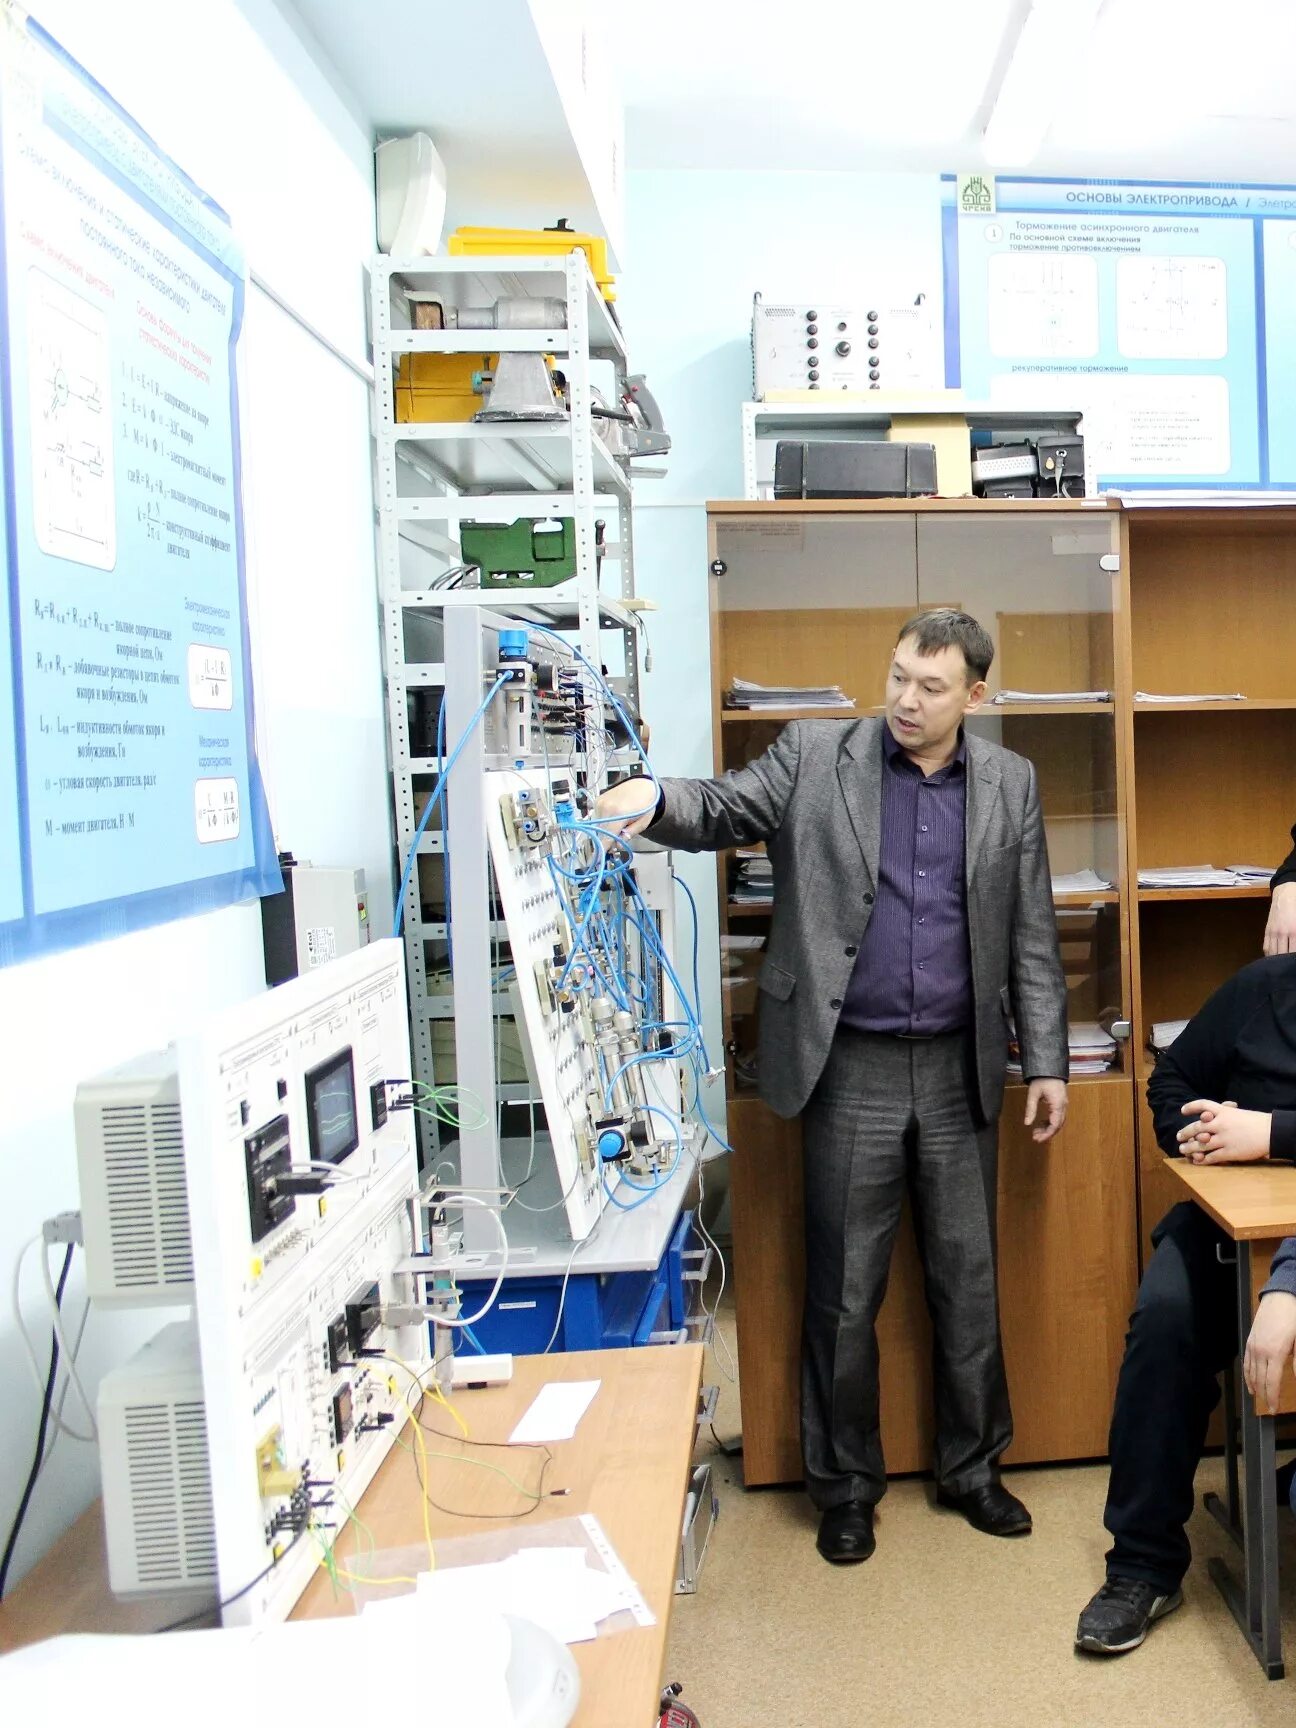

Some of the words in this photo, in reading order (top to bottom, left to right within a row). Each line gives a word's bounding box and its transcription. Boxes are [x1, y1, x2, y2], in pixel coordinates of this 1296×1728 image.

[1066, 192, 1122, 204] ОСНОВЫ
[1127, 193, 1238, 207] ЭЛЕКТРОПРИВОДА
[1016, 221, 1077, 232] Торможение
[1080, 223, 1150, 234] асинхронного
[1152, 226, 1200, 234] двигателя
[1009, 233, 1022, 241] По
[1023, 234, 1066, 242] основной
[1009, 244, 1059, 252] торможение
[1062, 245, 1141, 253] противовключением
[1011, 364, 1077, 373] рекуперативное
[1080, 365, 1129, 373] торможение
